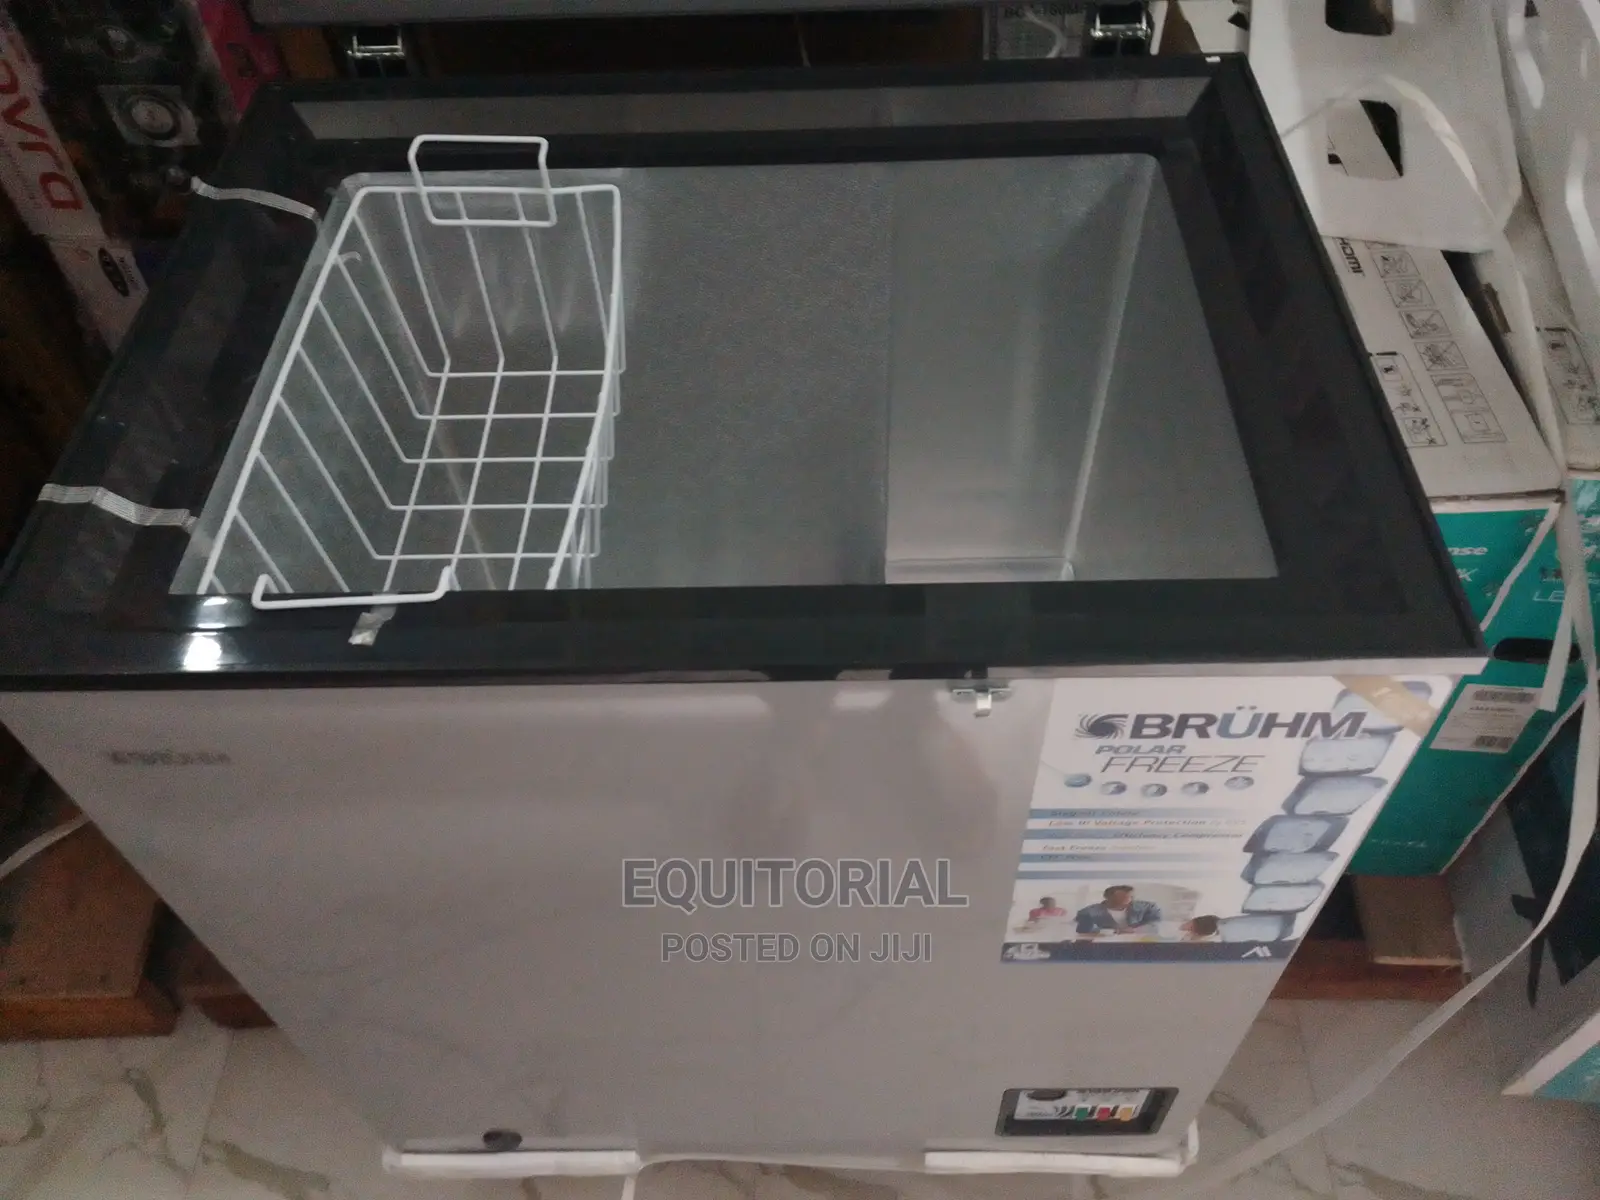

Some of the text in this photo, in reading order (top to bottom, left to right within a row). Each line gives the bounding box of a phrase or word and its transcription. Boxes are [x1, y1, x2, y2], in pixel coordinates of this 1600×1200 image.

[1129, 705, 1368, 740] BRÜHM
[1095, 744, 1187, 755] POLAR
[1100, 755, 1266, 774] FREEZE
[1143, 819, 1207, 827] Protection
